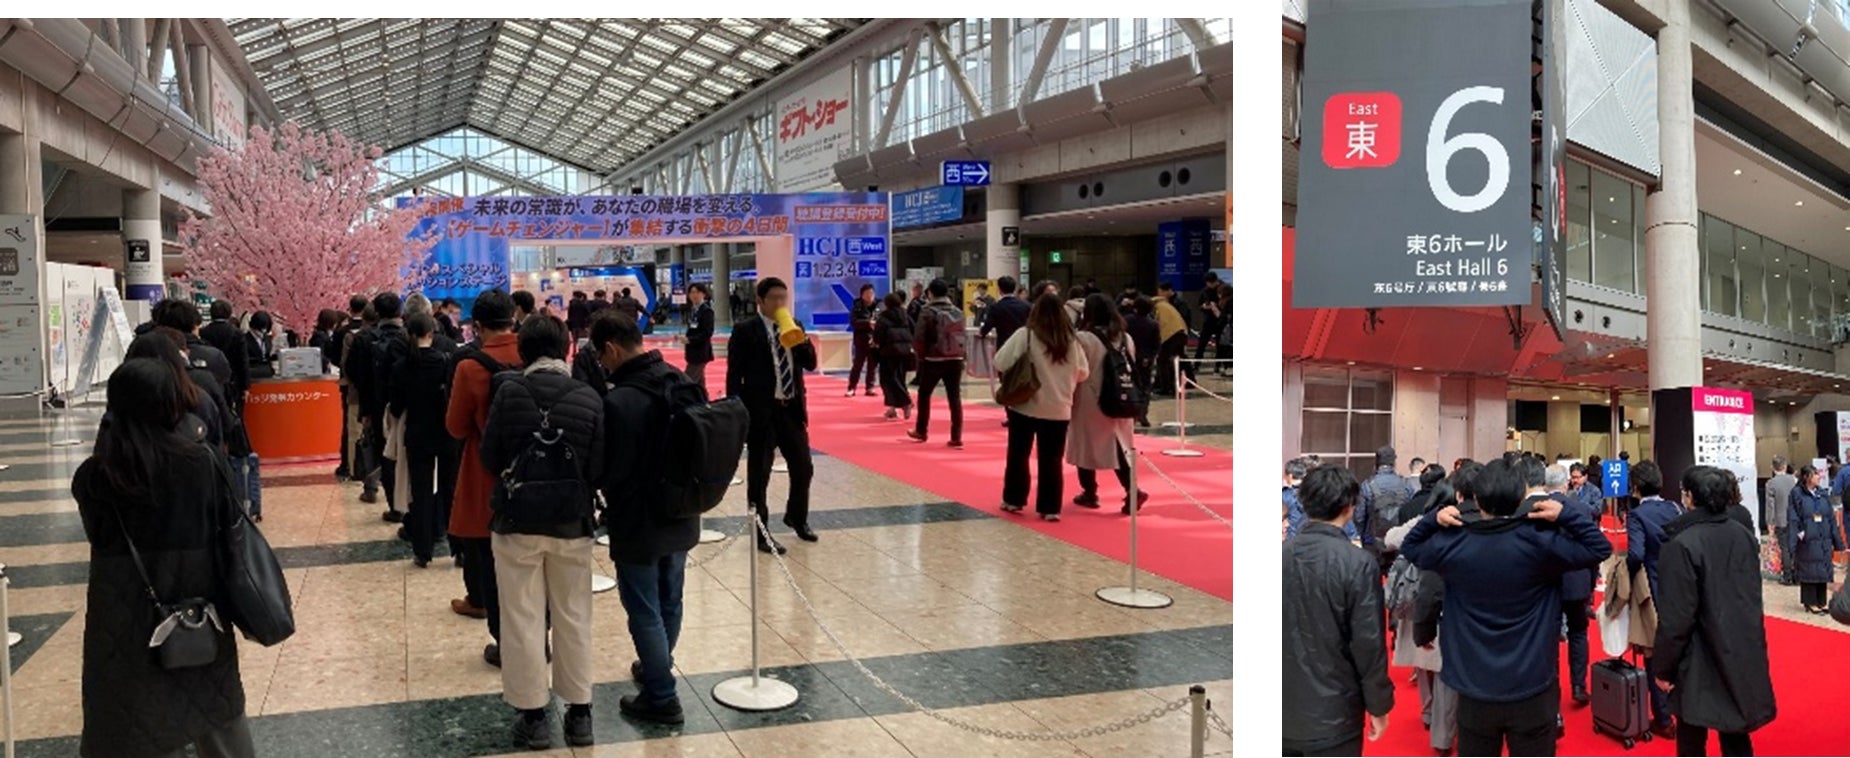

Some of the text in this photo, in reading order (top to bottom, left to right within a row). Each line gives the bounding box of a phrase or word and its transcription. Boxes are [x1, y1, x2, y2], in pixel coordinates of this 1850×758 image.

[1349, 103, 1378, 115] East
[1345, 121, 1379, 160] 東
[1426, 85, 1510, 212] 6
[946, 164, 960, 183] 西
[798, 237, 840, 257] HCJ
[848, 239, 861, 253] 西
[863, 242, 883, 251] West
[1407, 234, 1508, 255] 東6ホール
[813, 262, 857, 278] 1.2.3.4
[1416, 258, 1508, 276] East Hall 6
